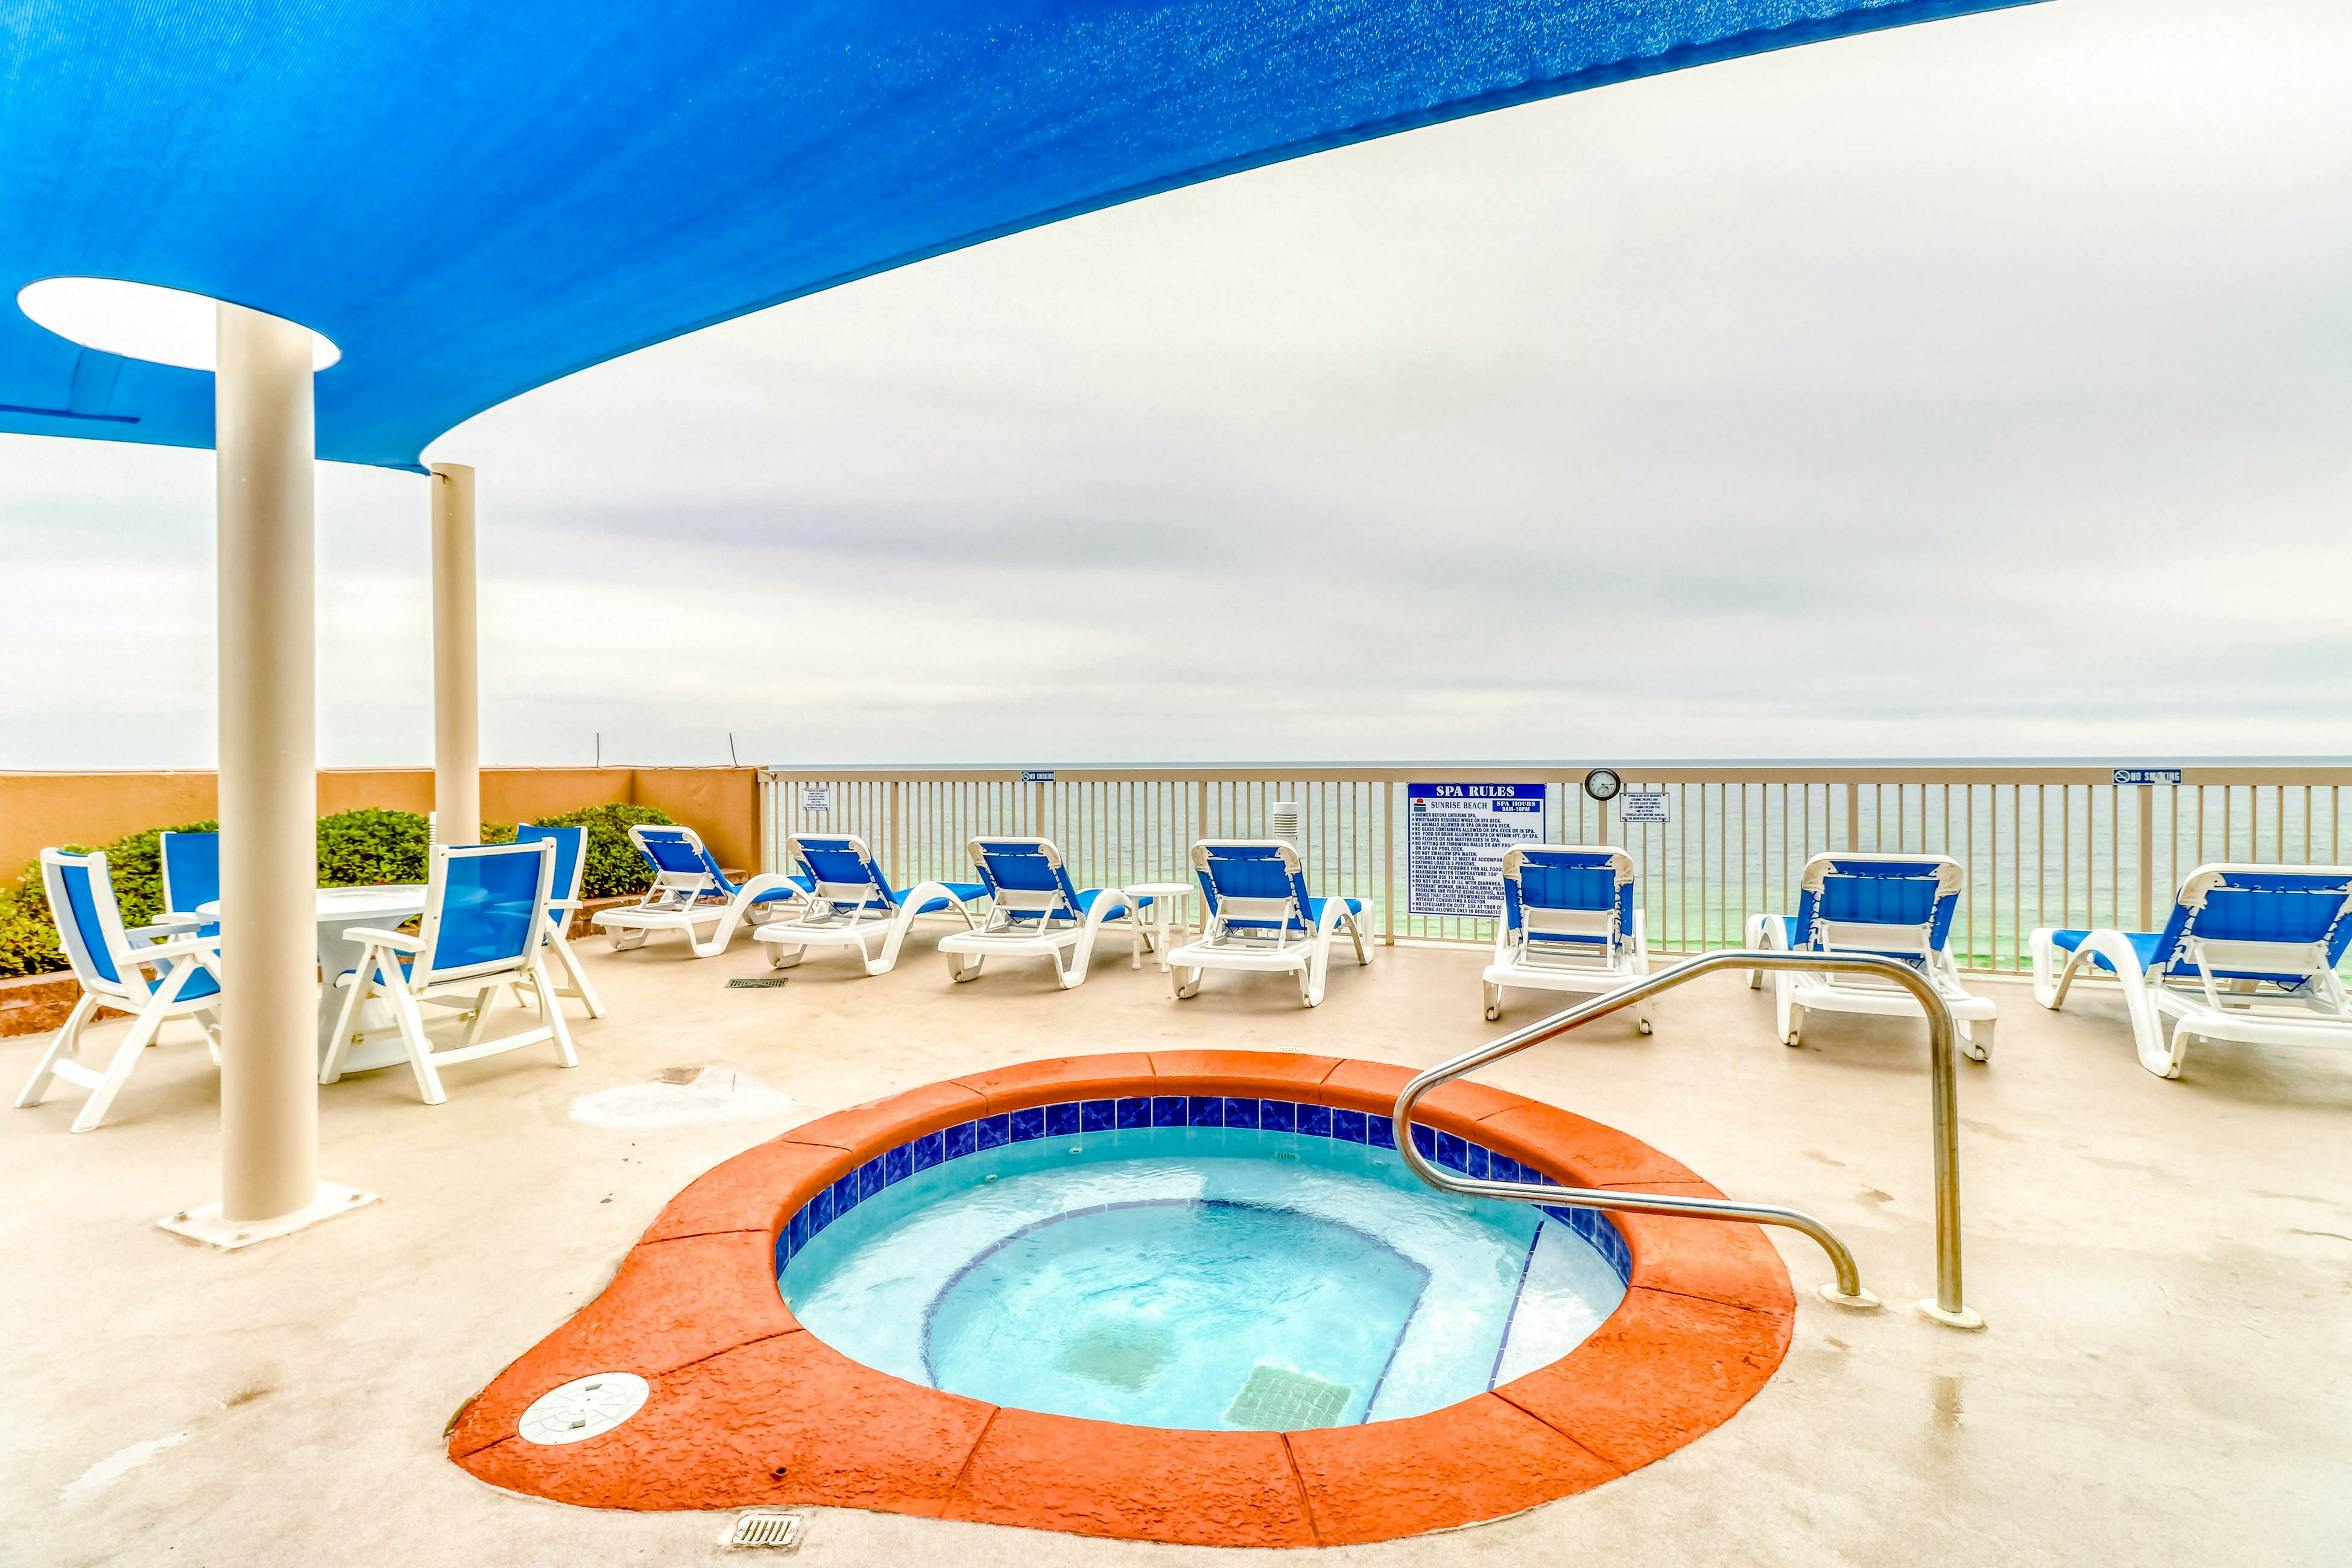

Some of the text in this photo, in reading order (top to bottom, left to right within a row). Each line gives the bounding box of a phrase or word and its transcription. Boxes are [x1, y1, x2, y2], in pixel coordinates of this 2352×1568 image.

[2131, 772, 2141, 781] NO
[1436, 786, 1515, 797] SPA RULES
